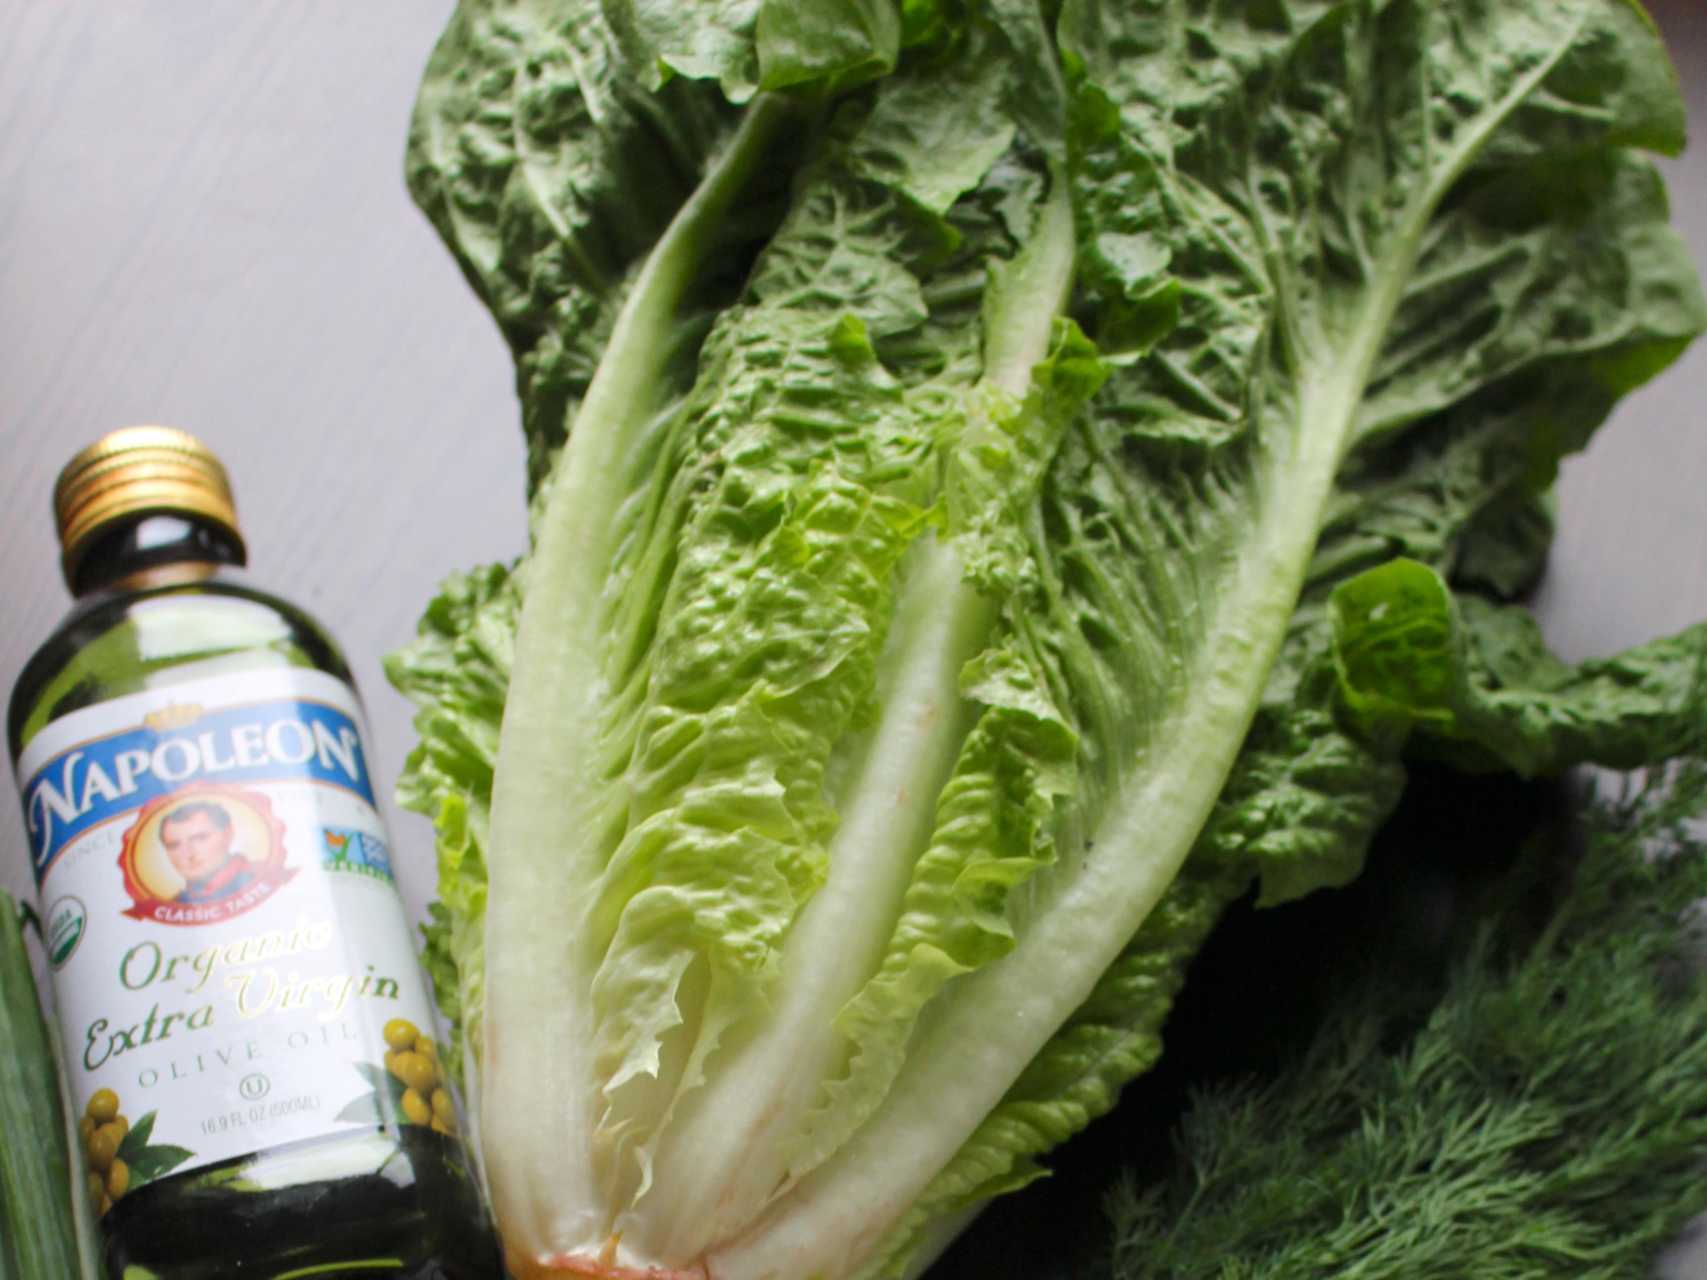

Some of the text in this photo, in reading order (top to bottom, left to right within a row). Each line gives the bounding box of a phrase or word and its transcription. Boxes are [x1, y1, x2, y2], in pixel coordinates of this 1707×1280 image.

[29, 719, 358, 867] NAPOLEON
[154, 905, 223, 921] CLASSIC
[119, 915, 333, 994] Organic
[82, 965, 400, 1072] Extra Virgin
[138, 1023, 358, 1090] OLIVE OIL
